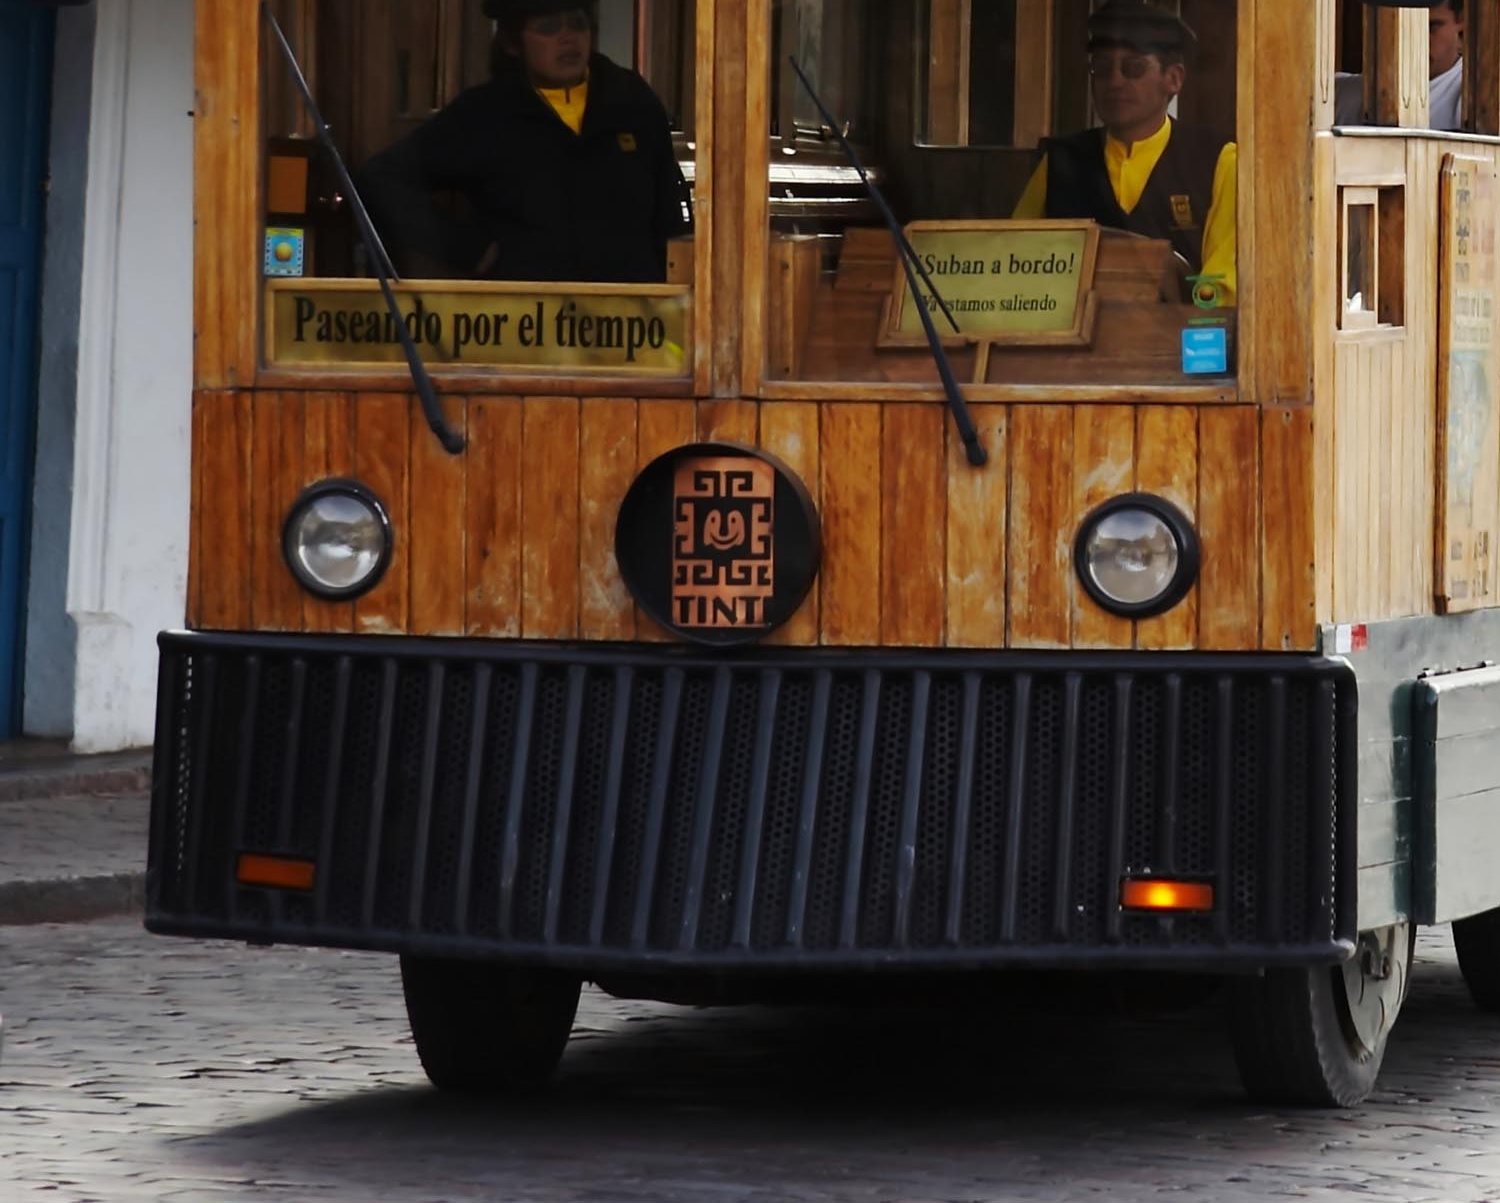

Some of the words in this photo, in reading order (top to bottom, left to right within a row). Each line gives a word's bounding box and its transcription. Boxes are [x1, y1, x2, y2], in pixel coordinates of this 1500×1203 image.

[989, 259, 1003, 275] a
[1007, 252, 1076, 276] bordo!
[998, 293, 1058, 313] saliendo
[293, 295, 442, 345] Paseando
[452, 312, 509, 359] por
[517, 301, 544, 348] el
[555, 304, 665, 362] tiempo
